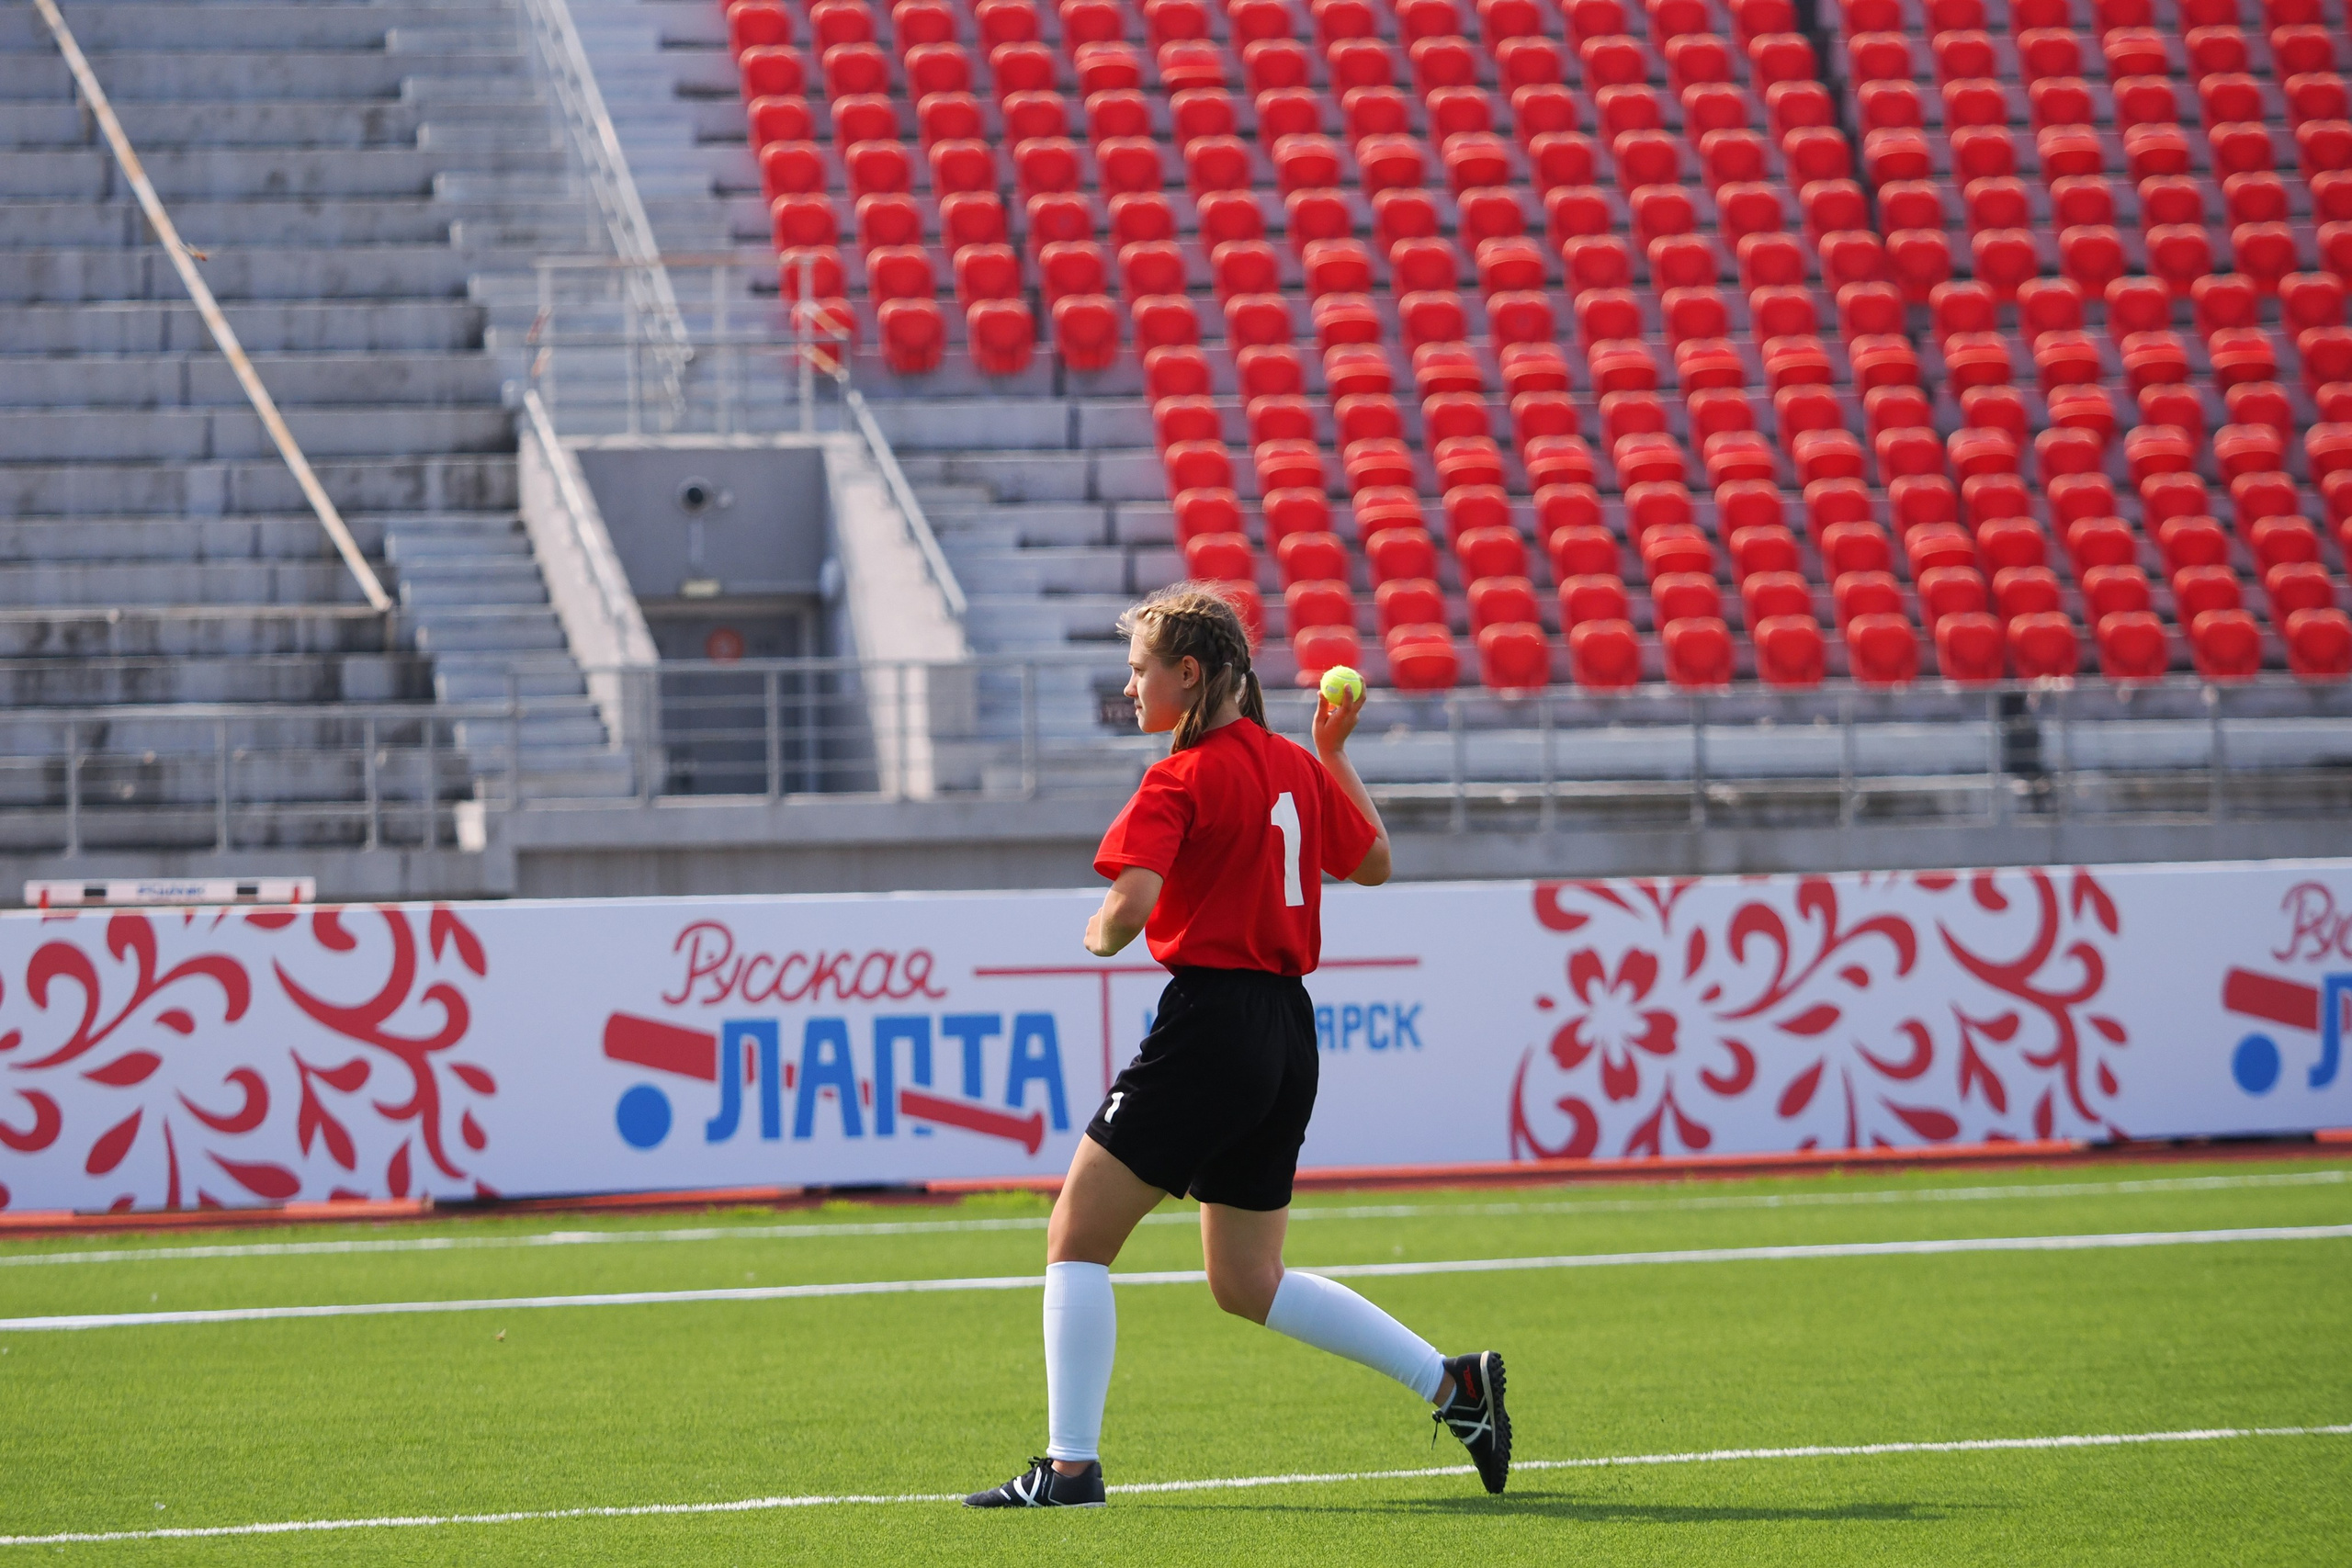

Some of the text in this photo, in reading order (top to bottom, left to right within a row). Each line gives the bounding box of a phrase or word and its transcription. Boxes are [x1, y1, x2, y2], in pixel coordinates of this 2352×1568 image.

[1271, 791, 1305, 907] 1
[662, 919, 947, 1007] Русская
[705, 1010, 1072, 1144] ЛАПТА
[1103, 1091, 1125, 1124] 1
